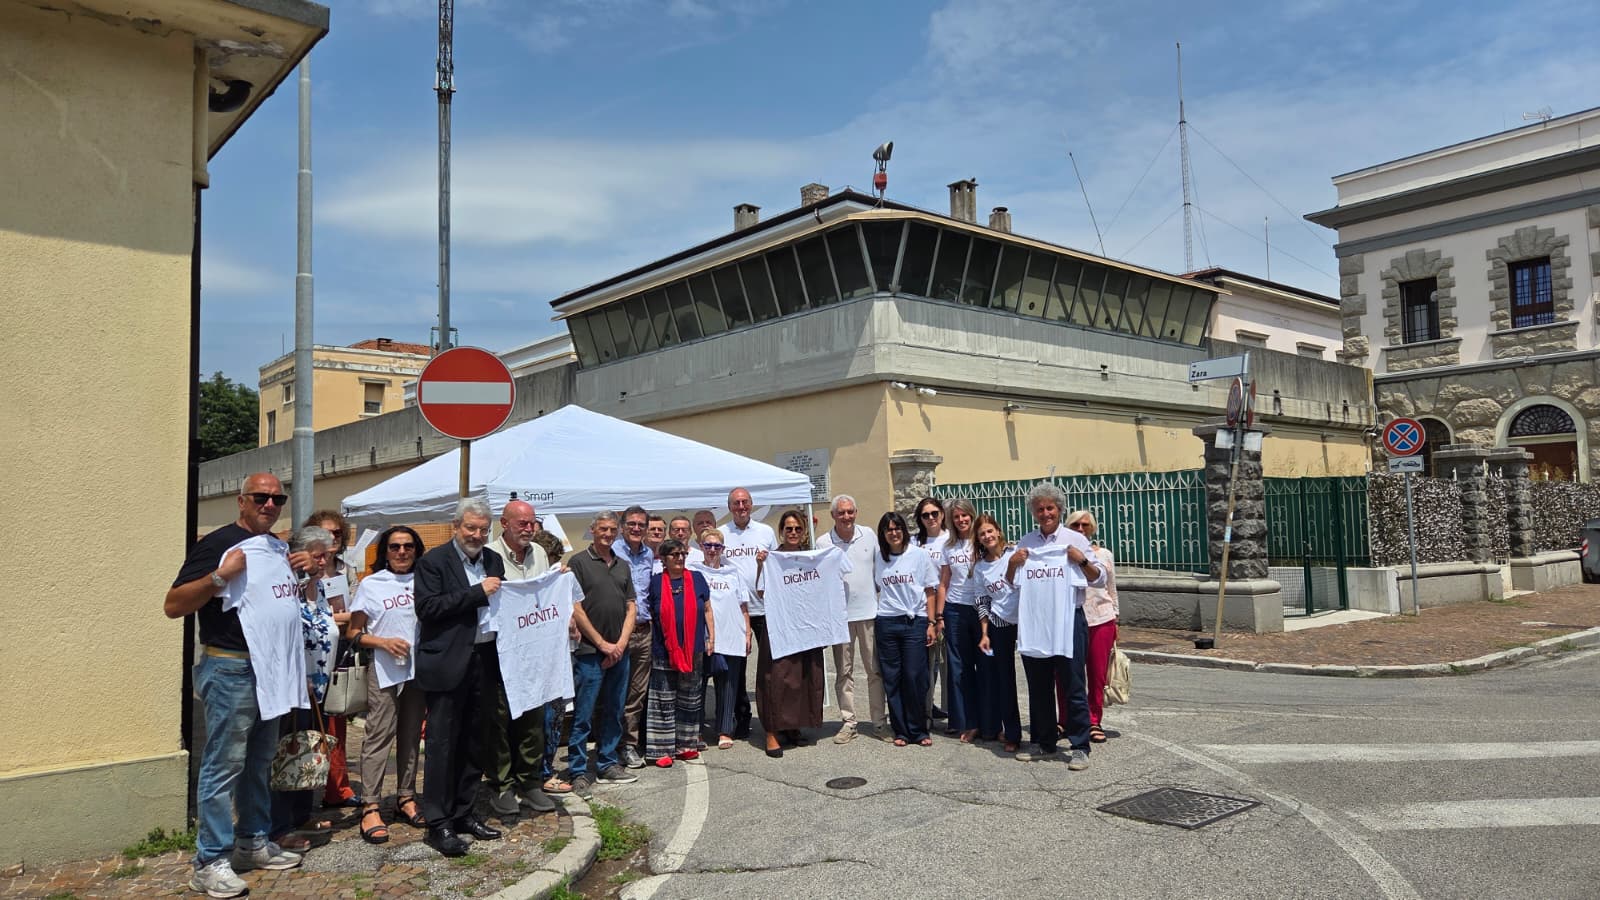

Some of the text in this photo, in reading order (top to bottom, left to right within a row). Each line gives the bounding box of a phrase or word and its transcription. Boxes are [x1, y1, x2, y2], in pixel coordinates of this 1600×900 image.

[523, 491, 554, 501] Smart
[950, 554, 971, 565] DIGN
[783, 568, 820, 584] DIGNITÀ
[1026, 566, 1065, 580] DIGNITÀ
[271, 583, 302, 599] DIGN
[709, 582, 730, 590] NITÀ
[383, 593, 415, 610] DIGN
[518, 604, 559, 629] DIGNITÀ
